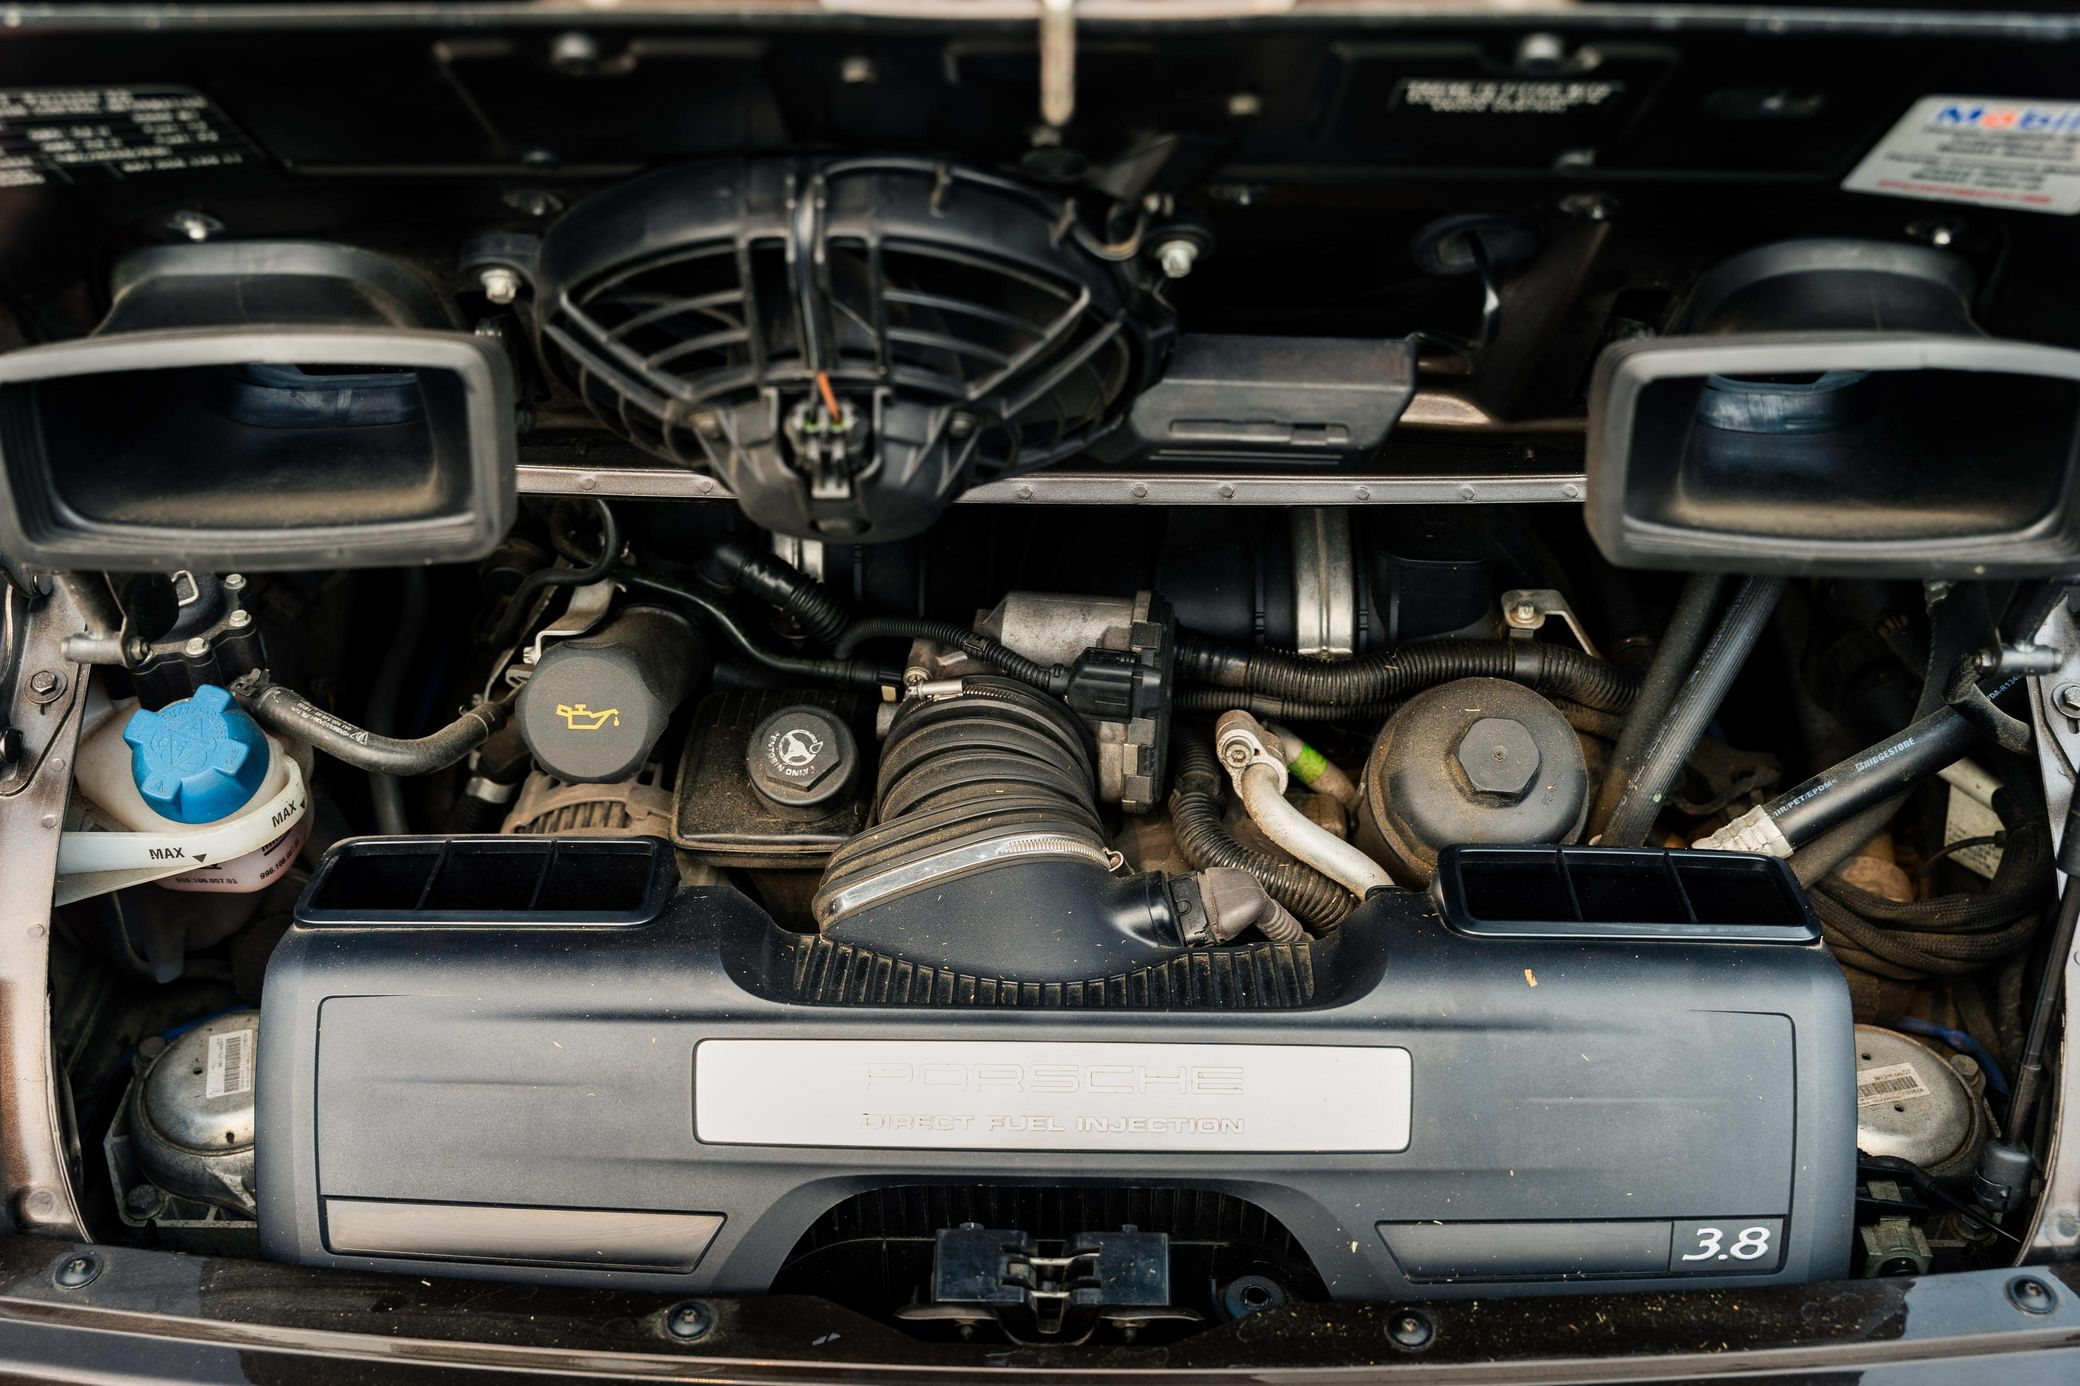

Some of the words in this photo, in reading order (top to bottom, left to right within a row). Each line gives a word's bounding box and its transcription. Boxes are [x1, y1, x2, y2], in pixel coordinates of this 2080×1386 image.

[1854, 737, 1916, 773] BRIDGESTONE
[271, 800, 297, 827] MAX
[149, 847, 185, 860] MAX
[863, 1062, 1244, 1095] PORSCHE
[862, 1113, 974, 1131] DIRECT
[987, 1114, 1065, 1132] FUEL
[1077, 1116, 1244, 1134] INJECTION
[1682, 1227, 1771, 1261] 3.8
